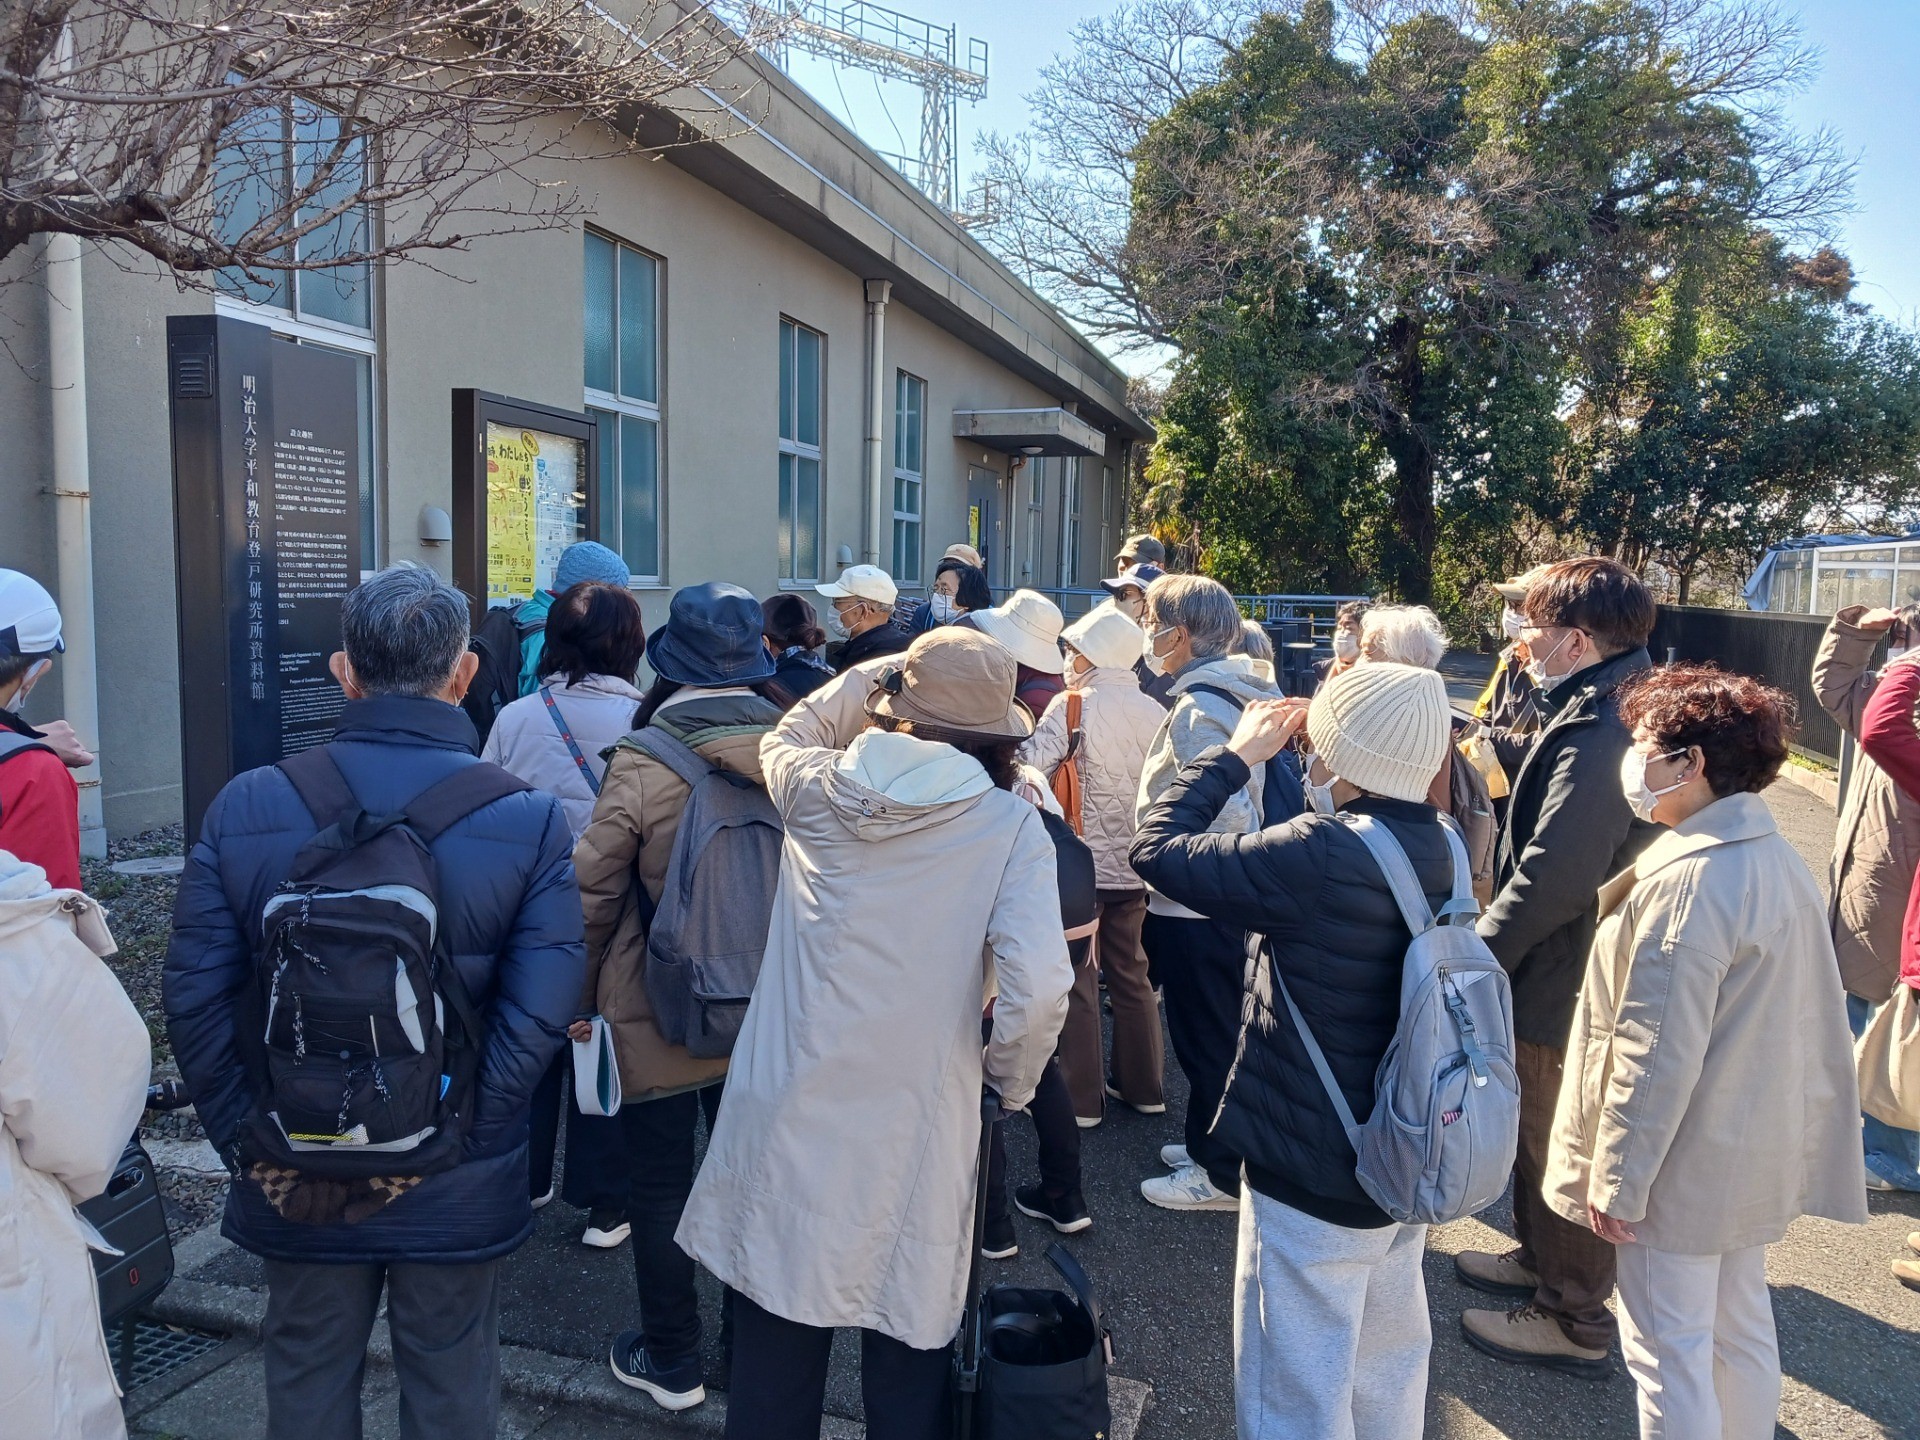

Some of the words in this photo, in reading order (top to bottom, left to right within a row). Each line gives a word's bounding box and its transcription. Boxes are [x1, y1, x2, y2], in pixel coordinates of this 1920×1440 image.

[242, 374, 265, 700] 明治大学平和教育登戸研究所資料館
[1188, 1183, 1212, 1202] N
[629, 1347, 647, 1374] N
